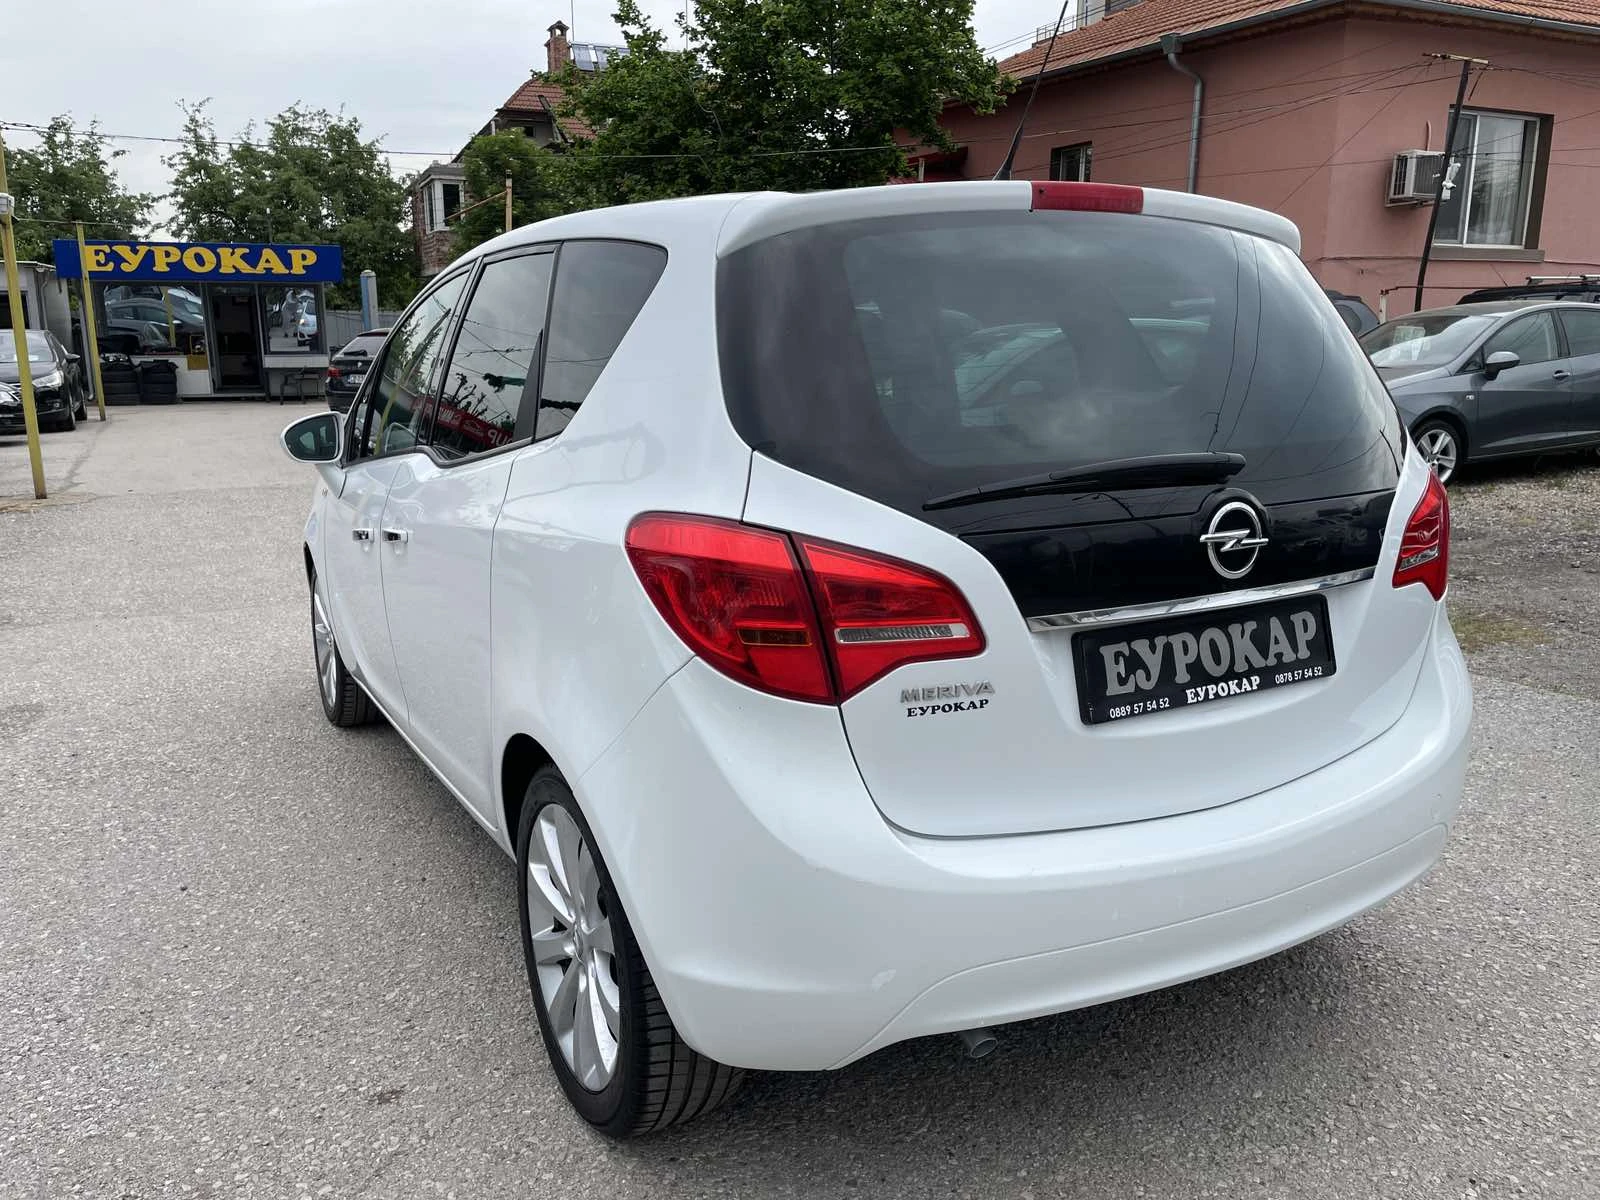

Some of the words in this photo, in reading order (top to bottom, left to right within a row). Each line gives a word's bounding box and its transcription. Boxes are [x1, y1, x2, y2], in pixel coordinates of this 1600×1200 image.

[84, 245, 317, 275] ЕУРОКАР
[1100, 611, 1316, 696] ЕУРОКАР
[1275, 672, 1292, 683] 0878
[1294, 670, 1302, 679] 57
[1304, 668, 1312, 678] 54
[1313, 666, 1322, 676] 52
[900, 681, 996, 703] MERIVA
[1186, 675, 1261, 704] ЕУРОКАР
[907, 699, 989, 717] ЕУРОКАР
[1109, 704, 1130, 718] 0889
[1133, 702, 1144, 714] 57
[1146, 700, 1157, 712] 54
[1159, 697, 1170, 710] 52
